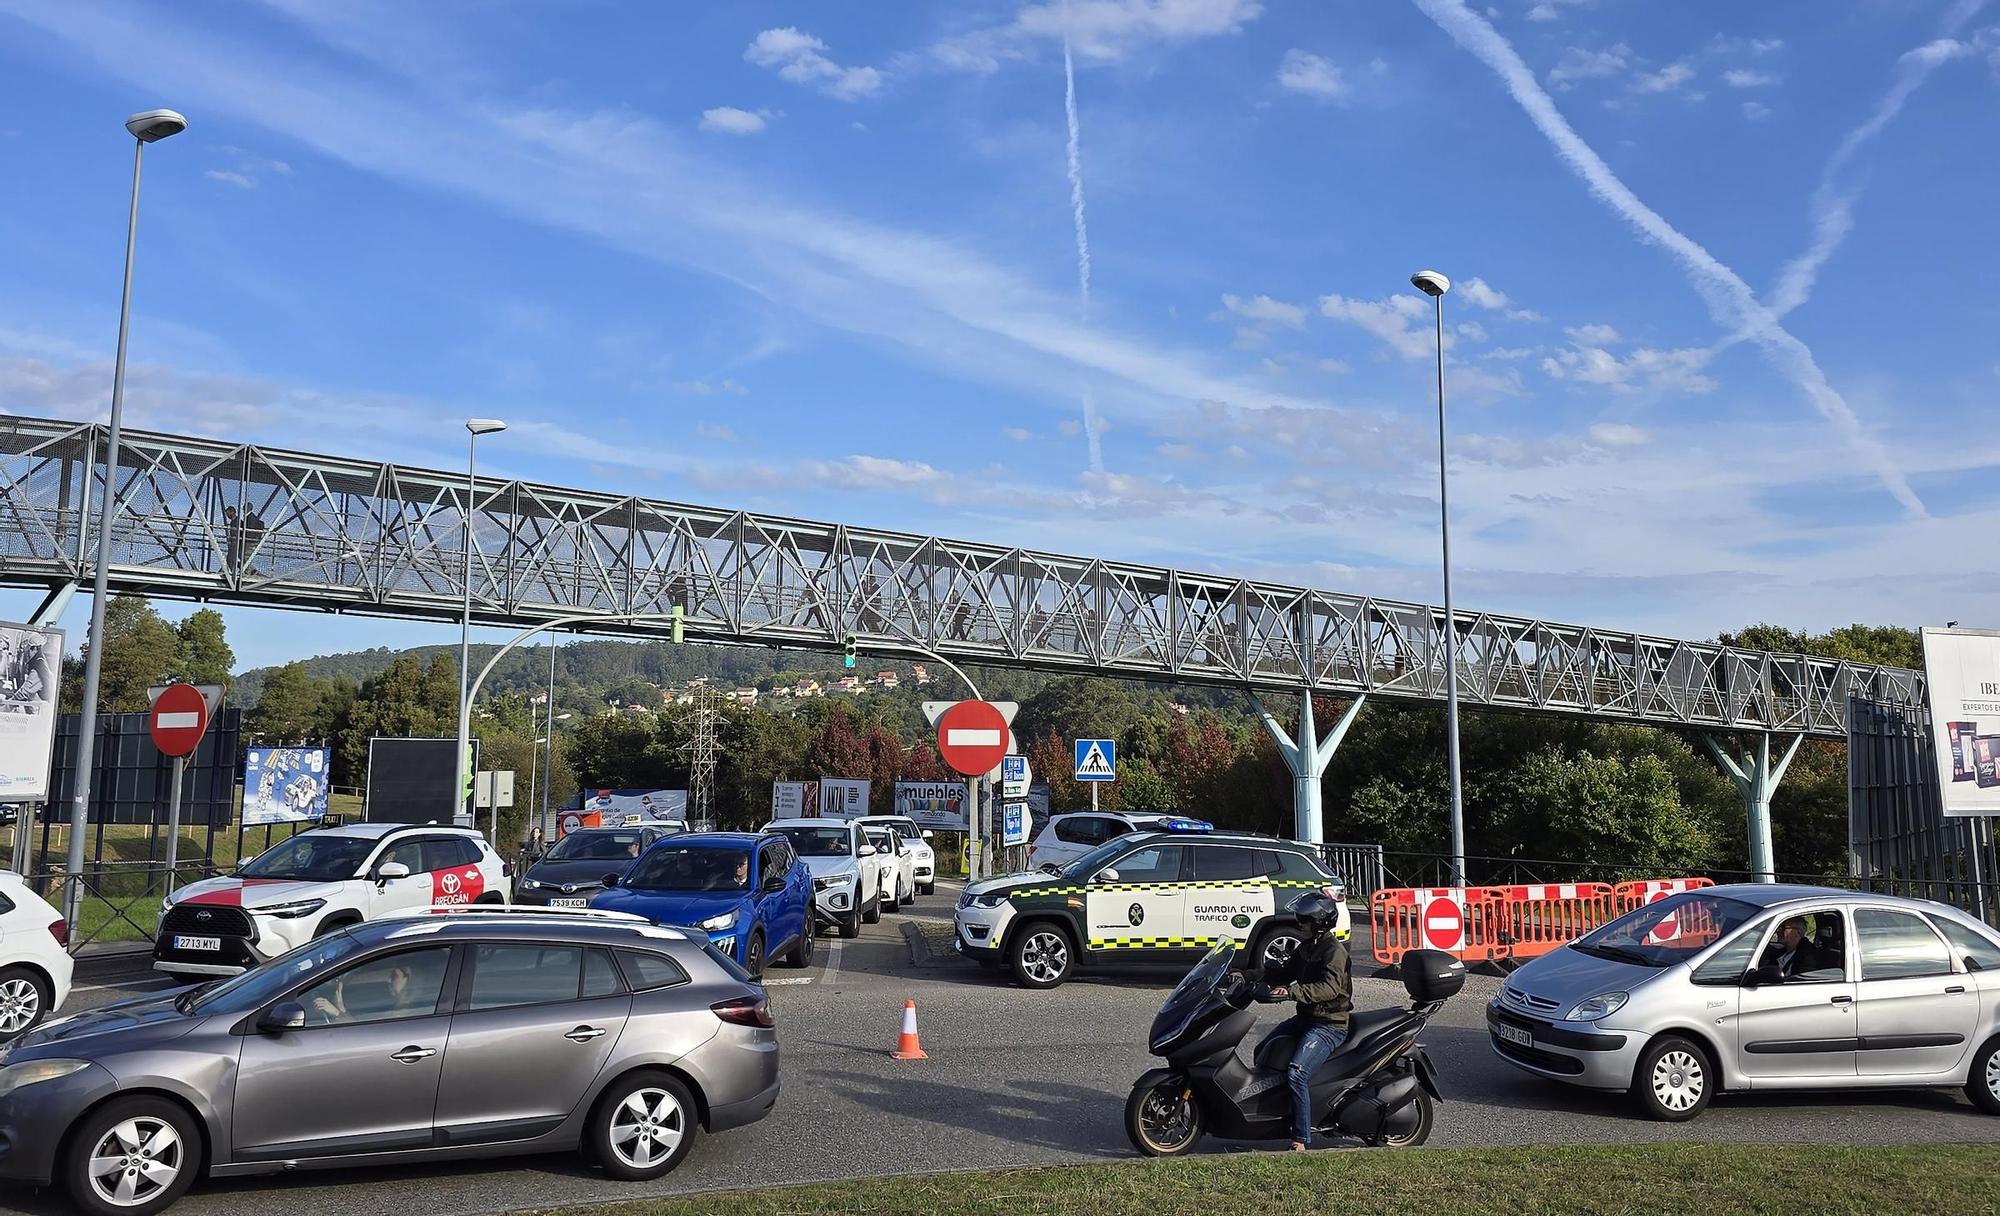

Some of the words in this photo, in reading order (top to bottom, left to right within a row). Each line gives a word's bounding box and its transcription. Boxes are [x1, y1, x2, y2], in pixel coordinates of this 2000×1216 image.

[904, 784, 964, 801] muebles
[180, 938, 201, 948] 2713
[203, 939, 218, 949] MYL
